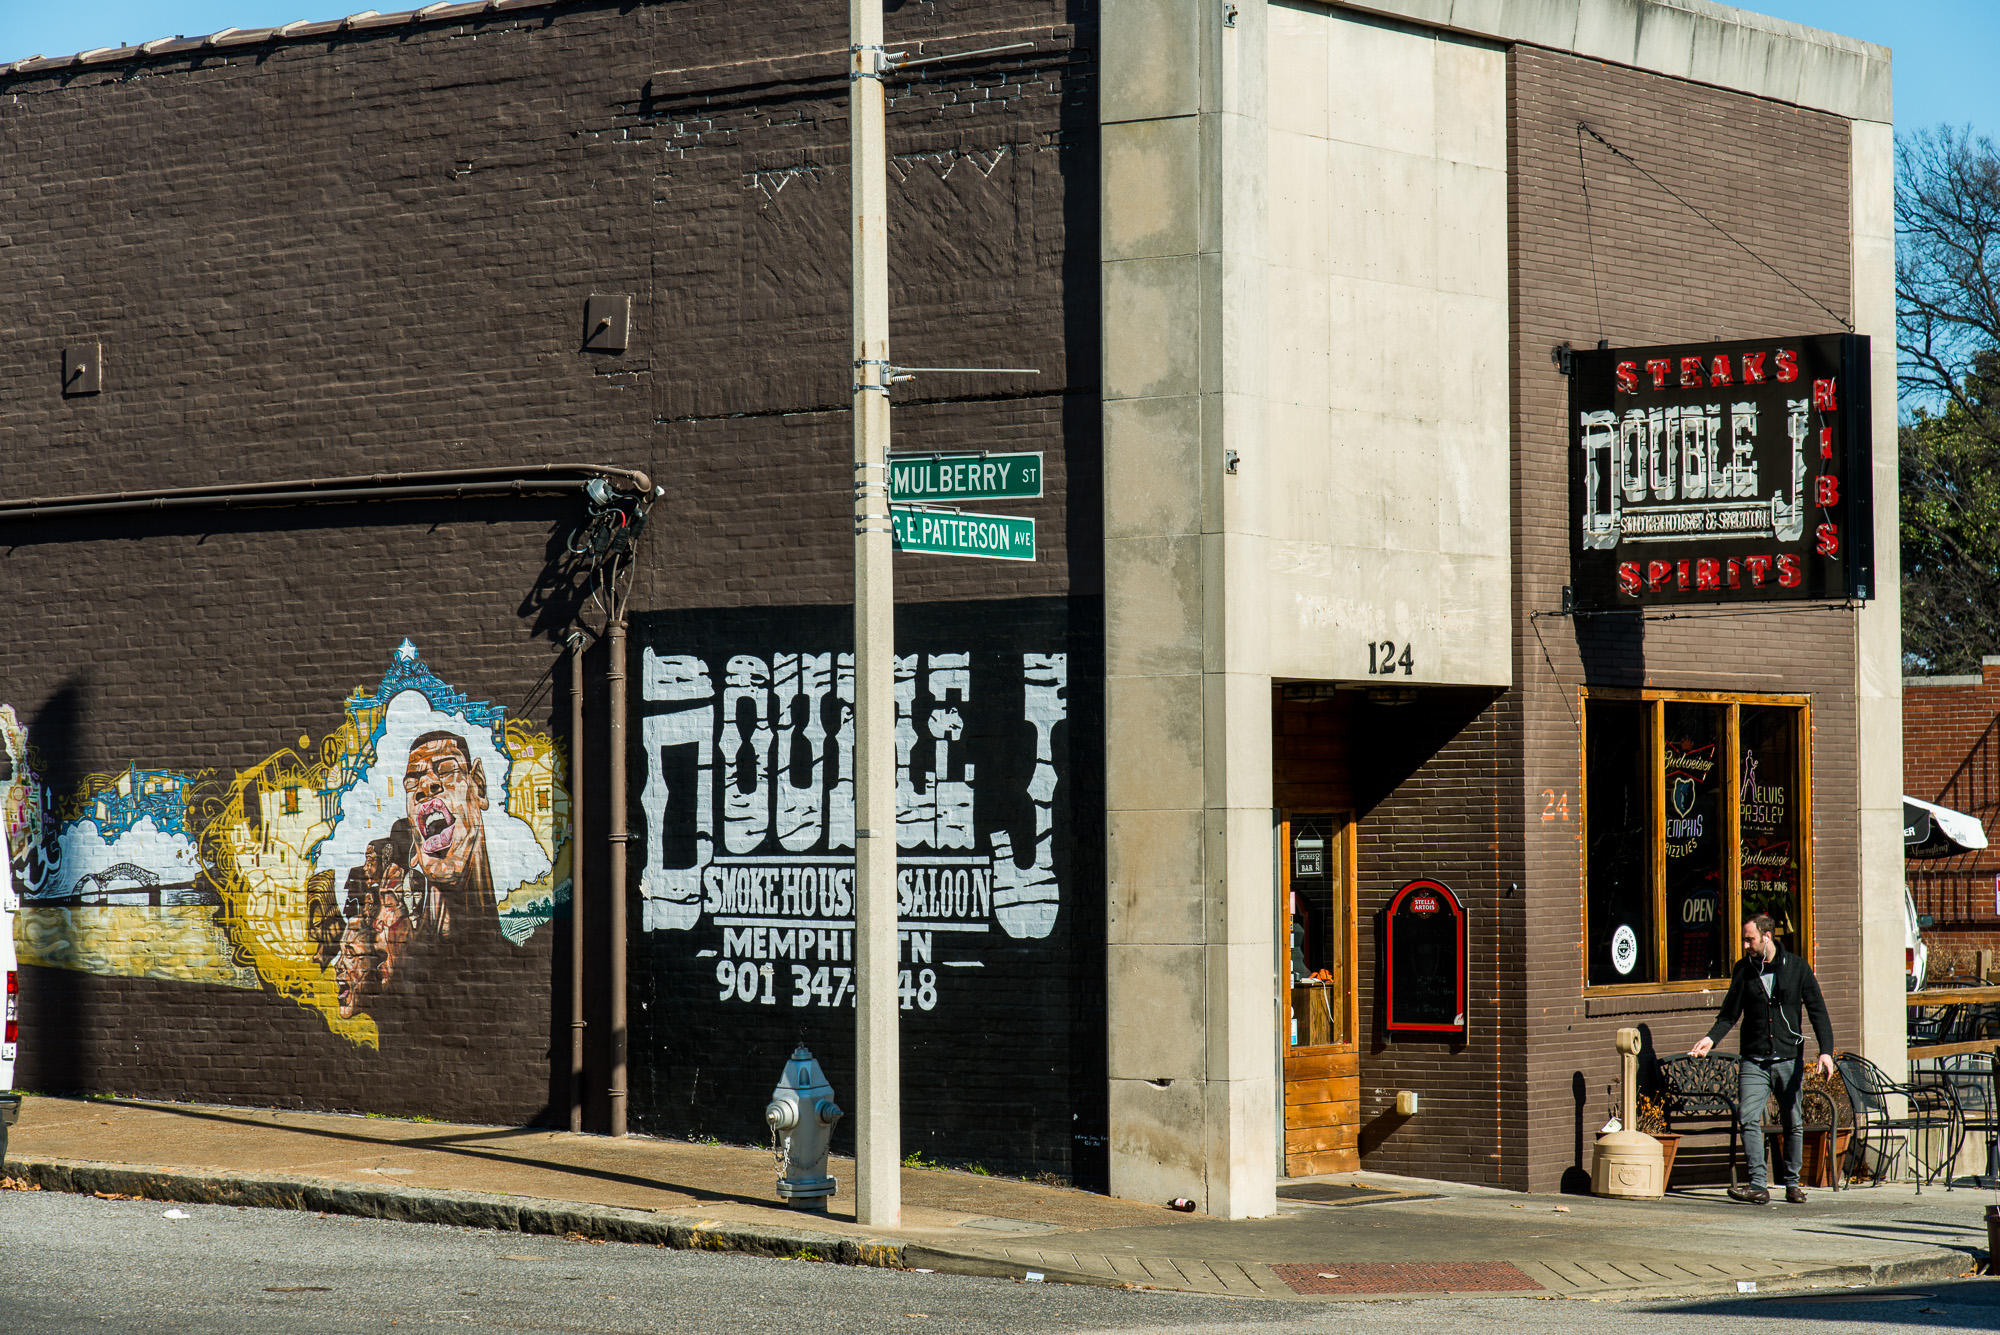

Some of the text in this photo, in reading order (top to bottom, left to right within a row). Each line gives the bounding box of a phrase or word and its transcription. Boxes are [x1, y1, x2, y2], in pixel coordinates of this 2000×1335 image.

[1615, 349, 1798, 394] STEAKS
[894, 462, 1037, 494] MULBERRY ST
[1580, 397, 1809, 550] DOUBLE J
[1813, 377, 1839, 557] RIBS
[1620, 512, 1704, 534] SMOKEHOUSE
[1717, 509, 1771, 530] SALOON
[1014, 531, 1031, 546] AVE
[1618, 553, 1802, 595] SPIRITS
[1368, 640, 1415, 675] 124
[1664, 750, 1716, 771] Budweiser
[989, 652, 1068, 938] J
[1541, 788, 1570, 821] 24
[1757, 785, 1785, 805] ELVIS
[1665, 814, 1704, 838] EMPHIS
[1301, 864, 1313, 872] BAR
[1741, 847, 1790, 867] Budweiser
[703, 866, 993, 918] SMOKEHOUS SALOON
[1682, 898, 1715, 923] OPEN
[723, 926, 852, 961] MEMPHI
[716, 960, 937, 1011] 901 347-48
